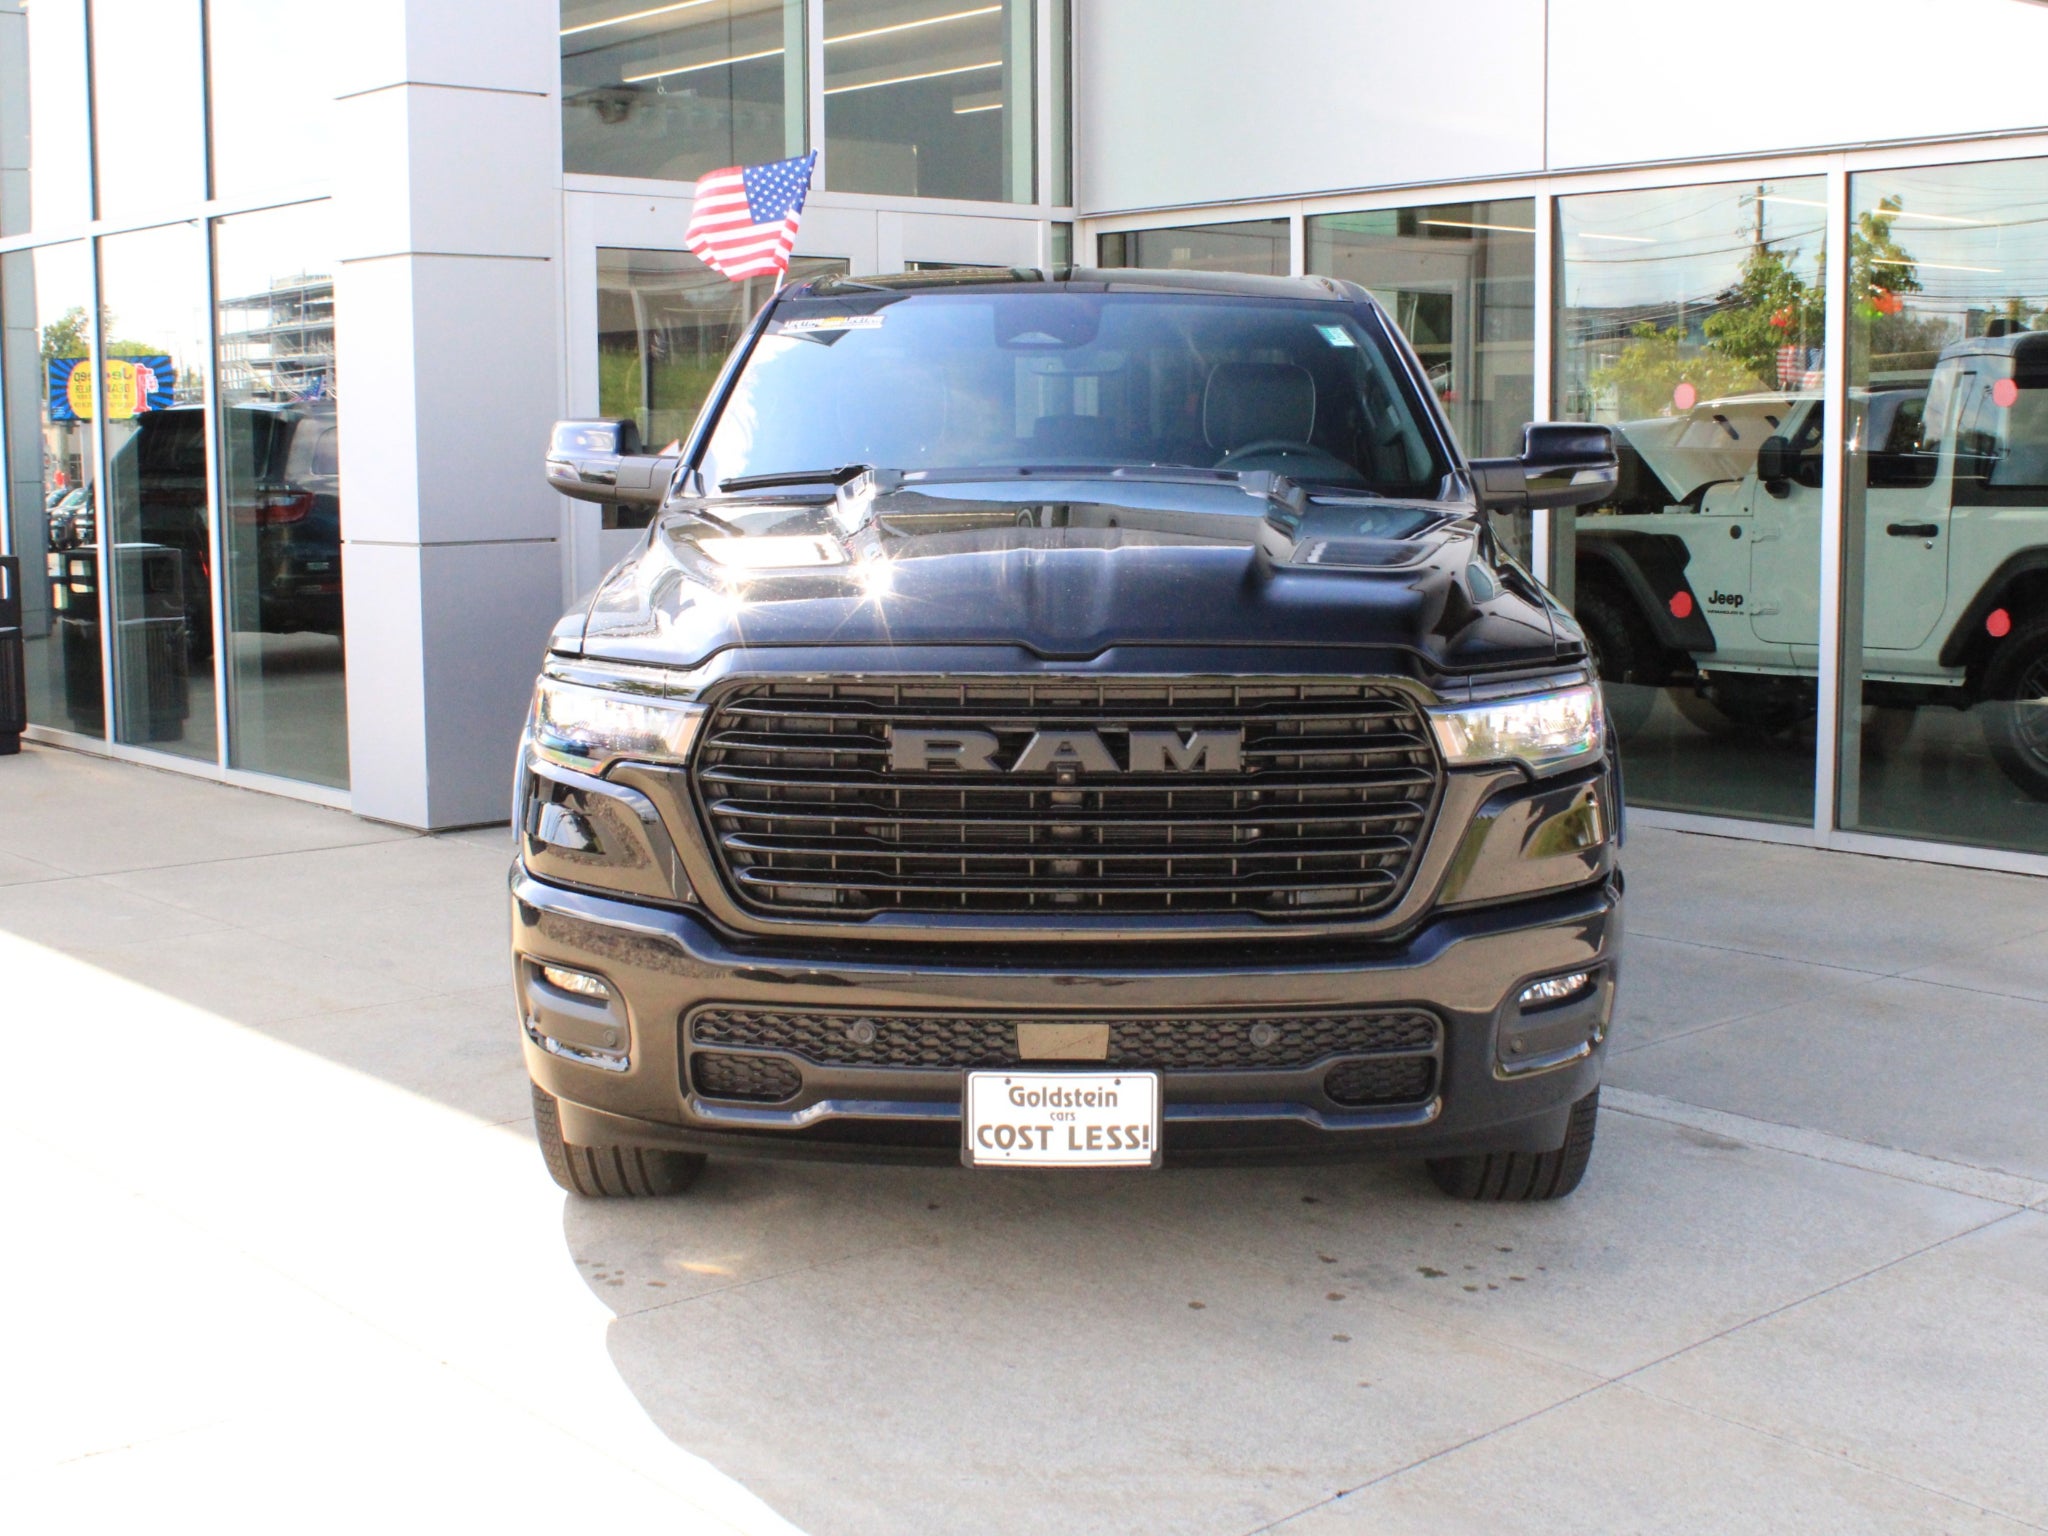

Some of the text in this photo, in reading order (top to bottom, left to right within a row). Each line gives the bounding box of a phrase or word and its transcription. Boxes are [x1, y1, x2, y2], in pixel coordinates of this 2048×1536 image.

[1708, 590, 1744, 608] Jeep
[891, 729, 1241, 772] RAM
[1008, 1086, 1118, 1108] Goldstein
[1050, 1112, 1076, 1121] cars
[977, 1124, 1150, 1150] COST LESS!
